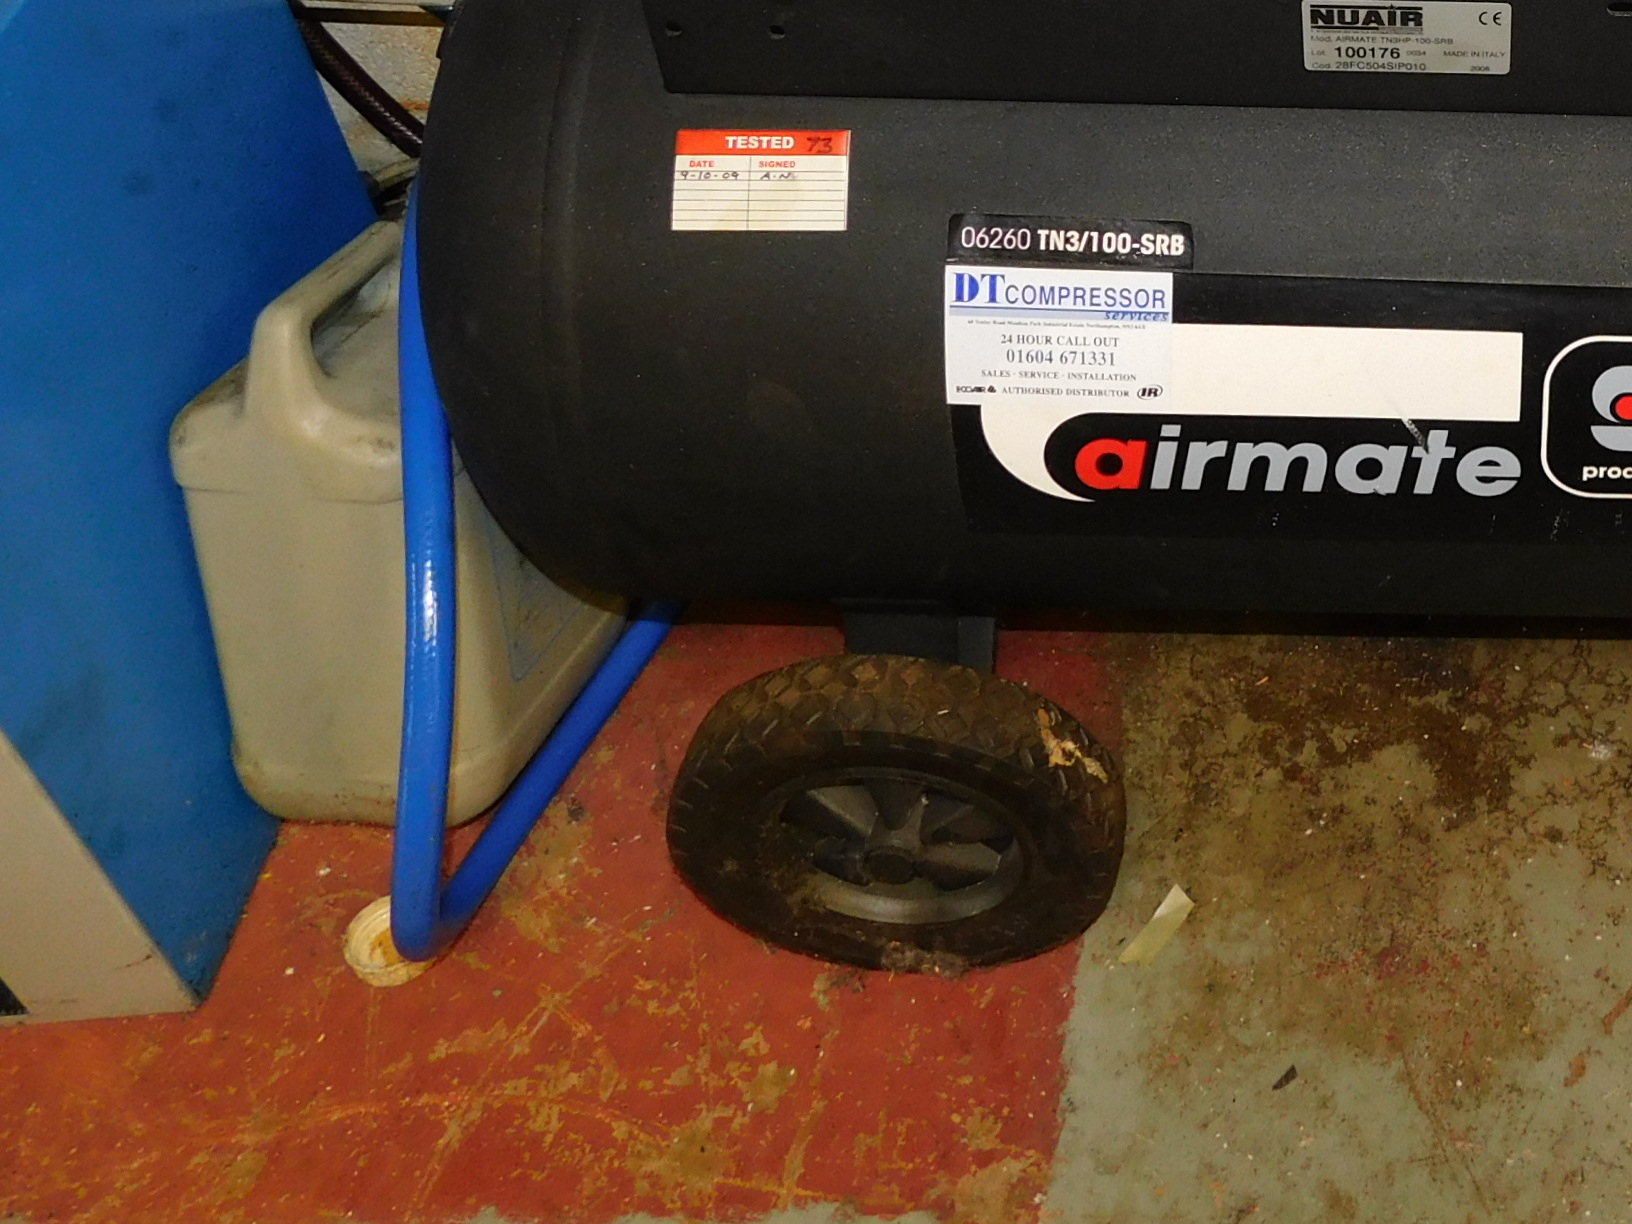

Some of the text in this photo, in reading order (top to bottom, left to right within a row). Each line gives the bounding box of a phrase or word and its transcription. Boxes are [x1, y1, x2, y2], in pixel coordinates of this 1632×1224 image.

[1310, 7, 1423, 27] NUAIR
[1334, 46, 1401, 59] 100176
[725, 136, 795, 149] TESTED
[689, 160, 714, 168] DATE
[758, 160, 796, 168] SIGNED
[961, 226, 1185, 256] 06260 TN3/100-SRB
[1104, 310, 1169, 322] services
[1001, 334, 1120, 347] 24 HOUR CALL OUT
[1006, 348, 1116, 366] 01604 671331
[981, 369, 1136, 381] SALES SERVICE INSTALLATION
[1001, 386, 1063, 395] AUTHORISED
[1065, 387, 1130, 397] DISTRIBUTOR
[1074, 423, 1522, 496] airmate
